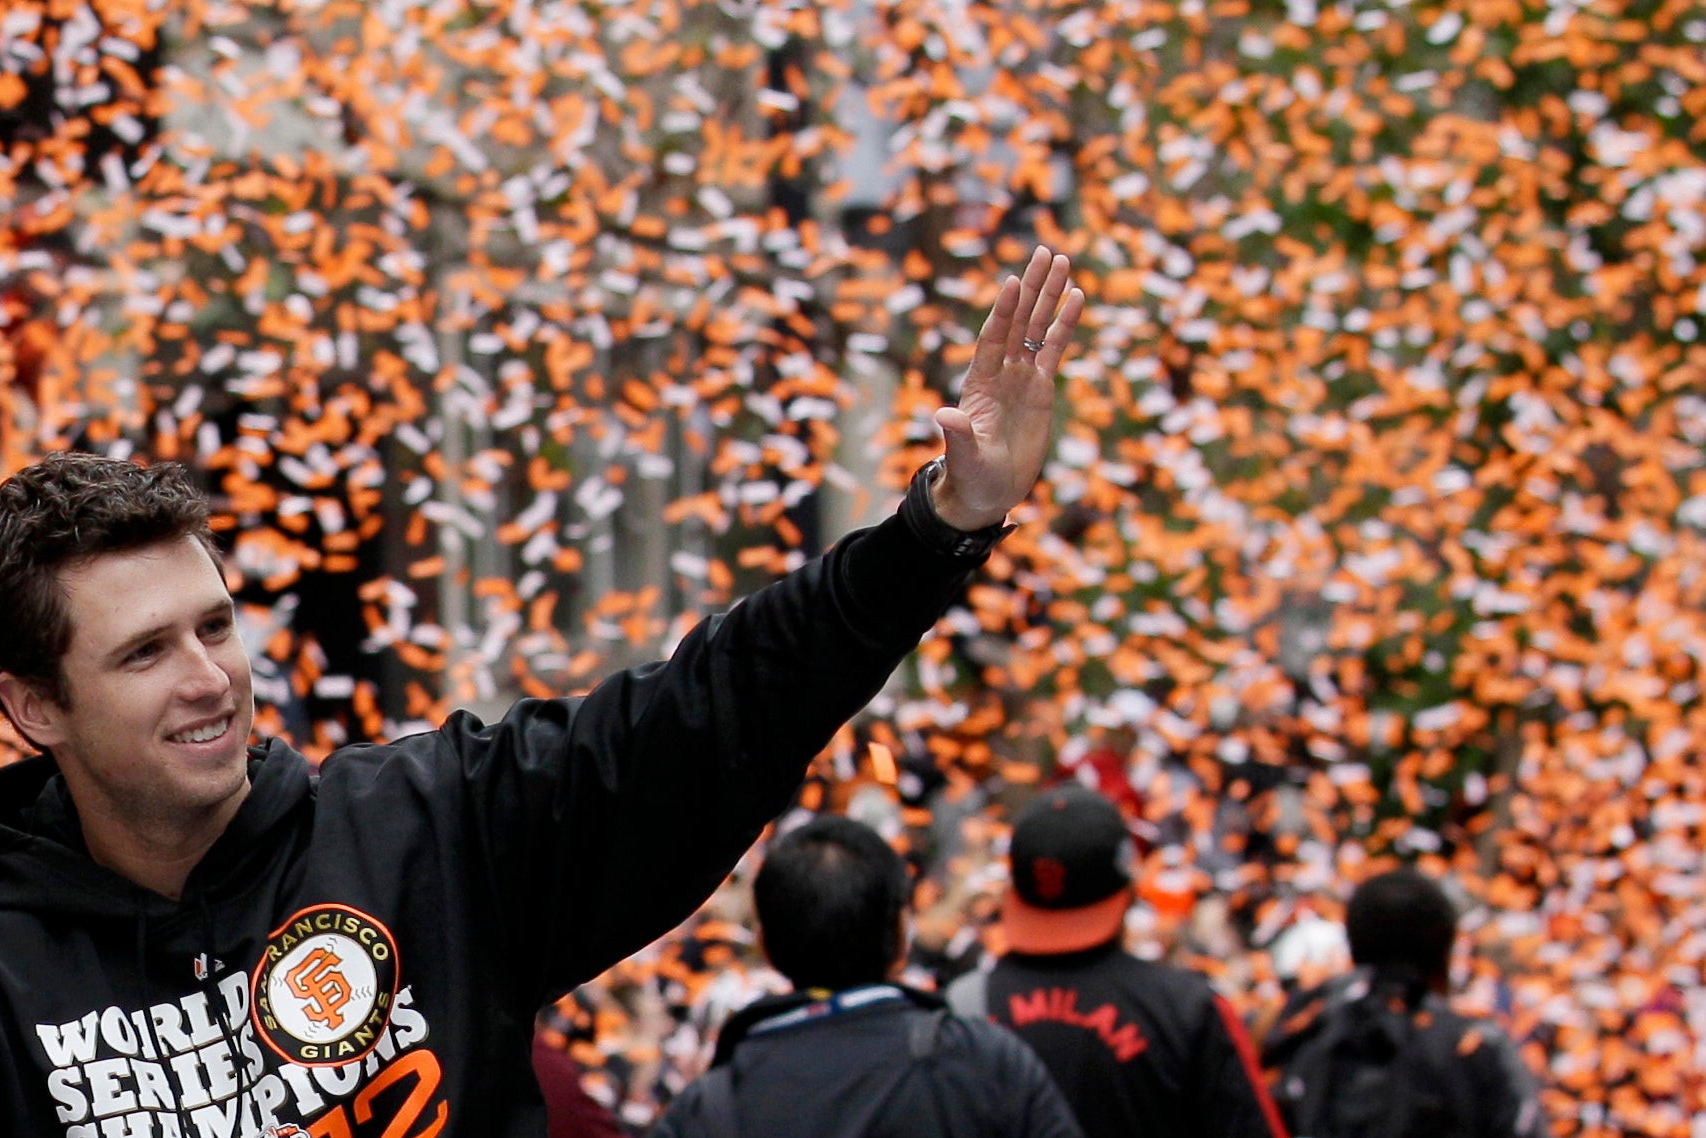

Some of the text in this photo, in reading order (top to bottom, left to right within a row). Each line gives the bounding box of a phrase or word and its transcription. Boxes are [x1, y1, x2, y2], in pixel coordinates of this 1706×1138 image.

[266, 914, 389, 961] RANCISCO
[36, 971, 250, 1067] WORLD
[300, 992, 390, 1059] GIANTS
[1008, 986, 1150, 1064] MILAN
[48, 1020, 264, 1123] SERIES
